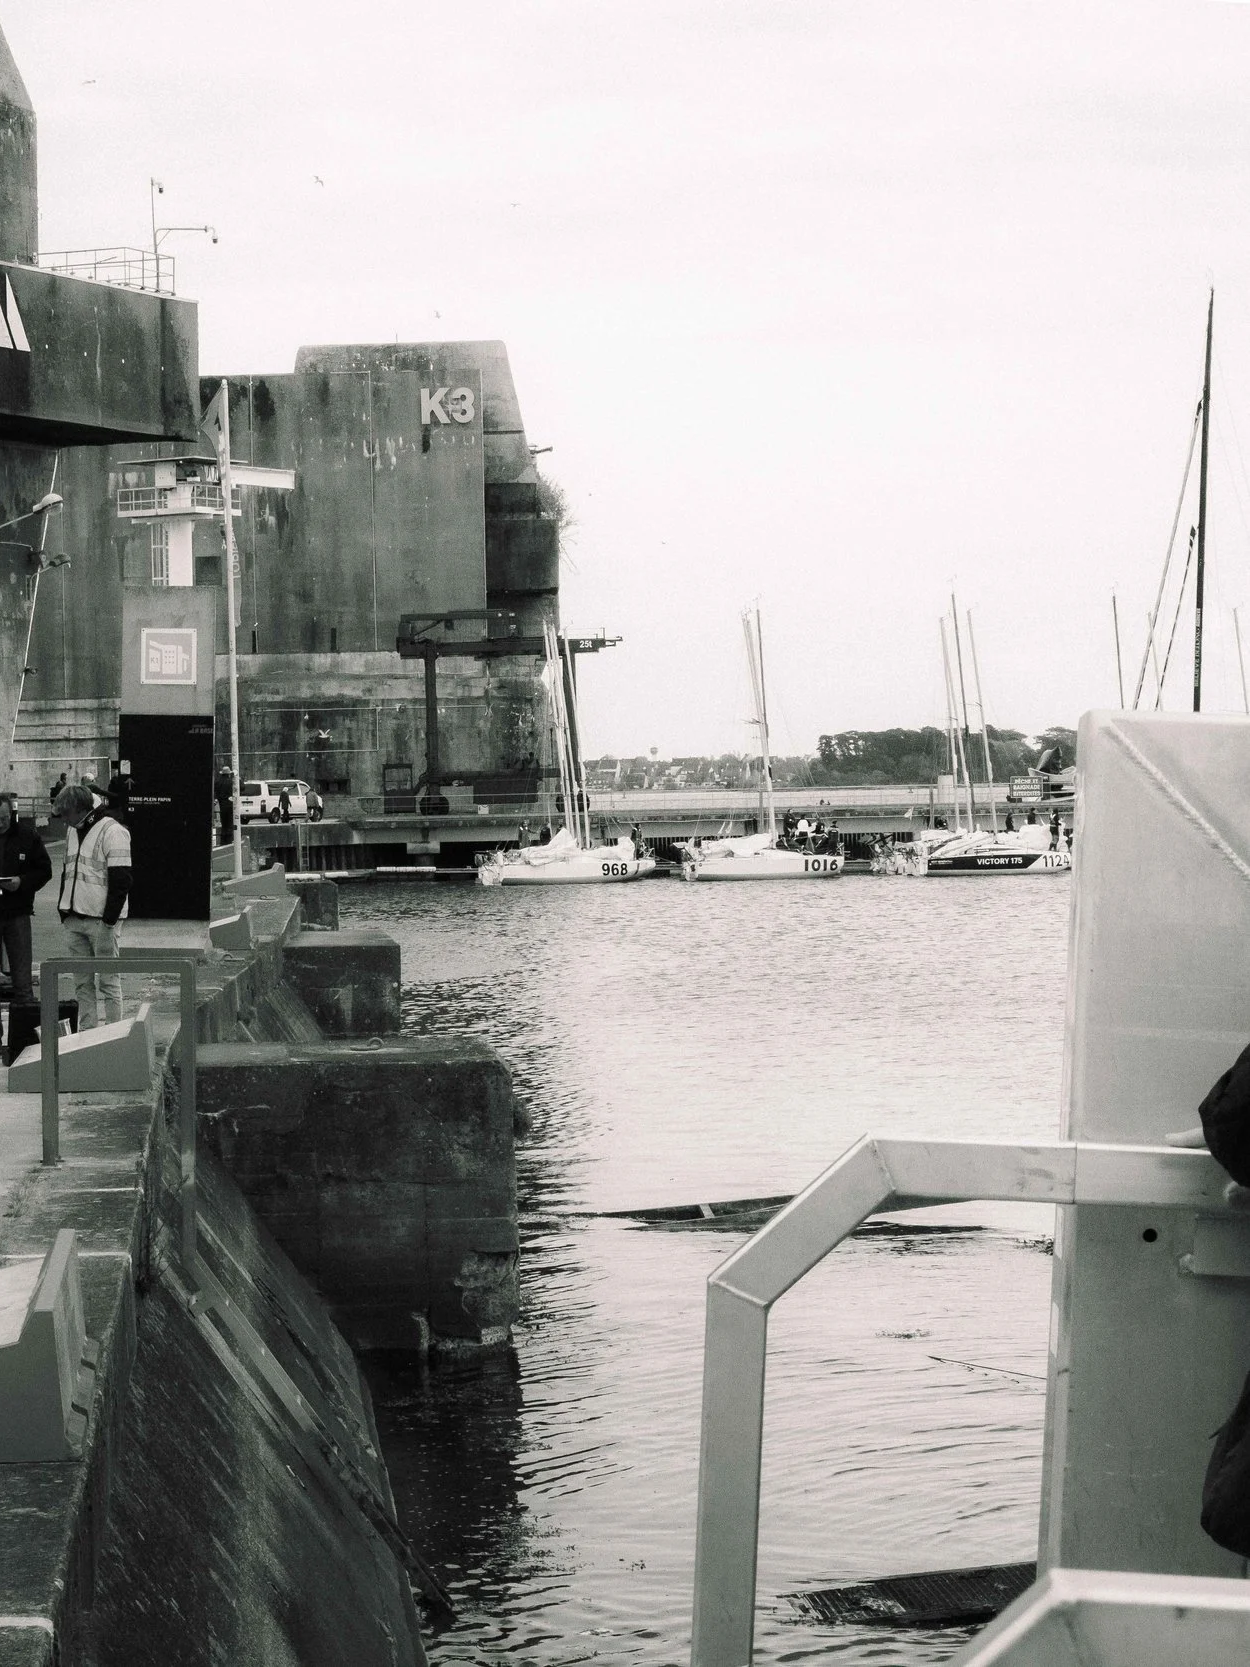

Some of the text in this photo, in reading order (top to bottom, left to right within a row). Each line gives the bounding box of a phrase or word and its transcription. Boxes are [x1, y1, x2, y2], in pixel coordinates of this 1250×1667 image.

[420, 387, 475, 425] K3
[579, 640, 593, 648] 25t
[804, 859, 838, 871] 1016
[1043, 855, 1070, 867] 1124
[602, 863, 628, 876] 968
